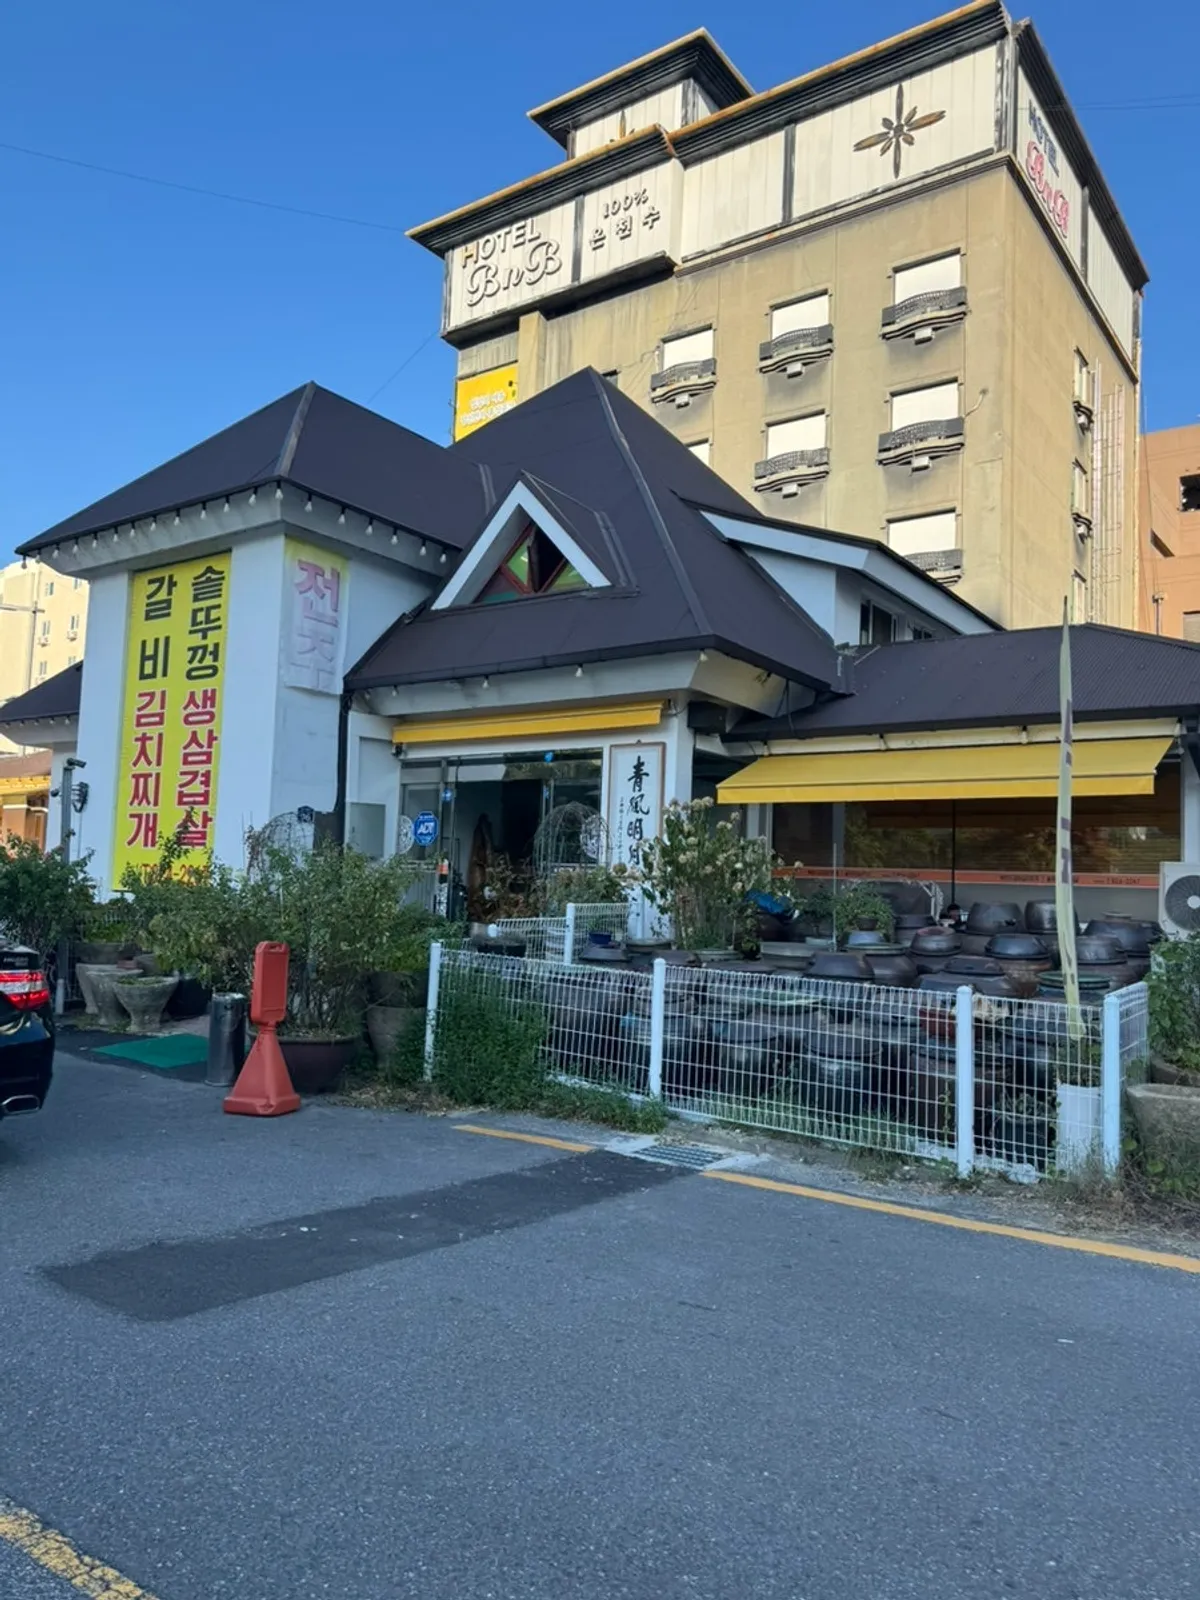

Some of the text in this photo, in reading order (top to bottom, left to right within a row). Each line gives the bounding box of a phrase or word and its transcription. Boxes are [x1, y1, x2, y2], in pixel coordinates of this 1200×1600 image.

[603, 188, 649, 219] 100%
[461, 217, 542, 269] HOTEL
[466, 238, 563, 307] BnB
[126, 574, 178, 849] 갈비 김치찌개
[176, 565, 226, 848] 솥뚜껑 생삼겹살
